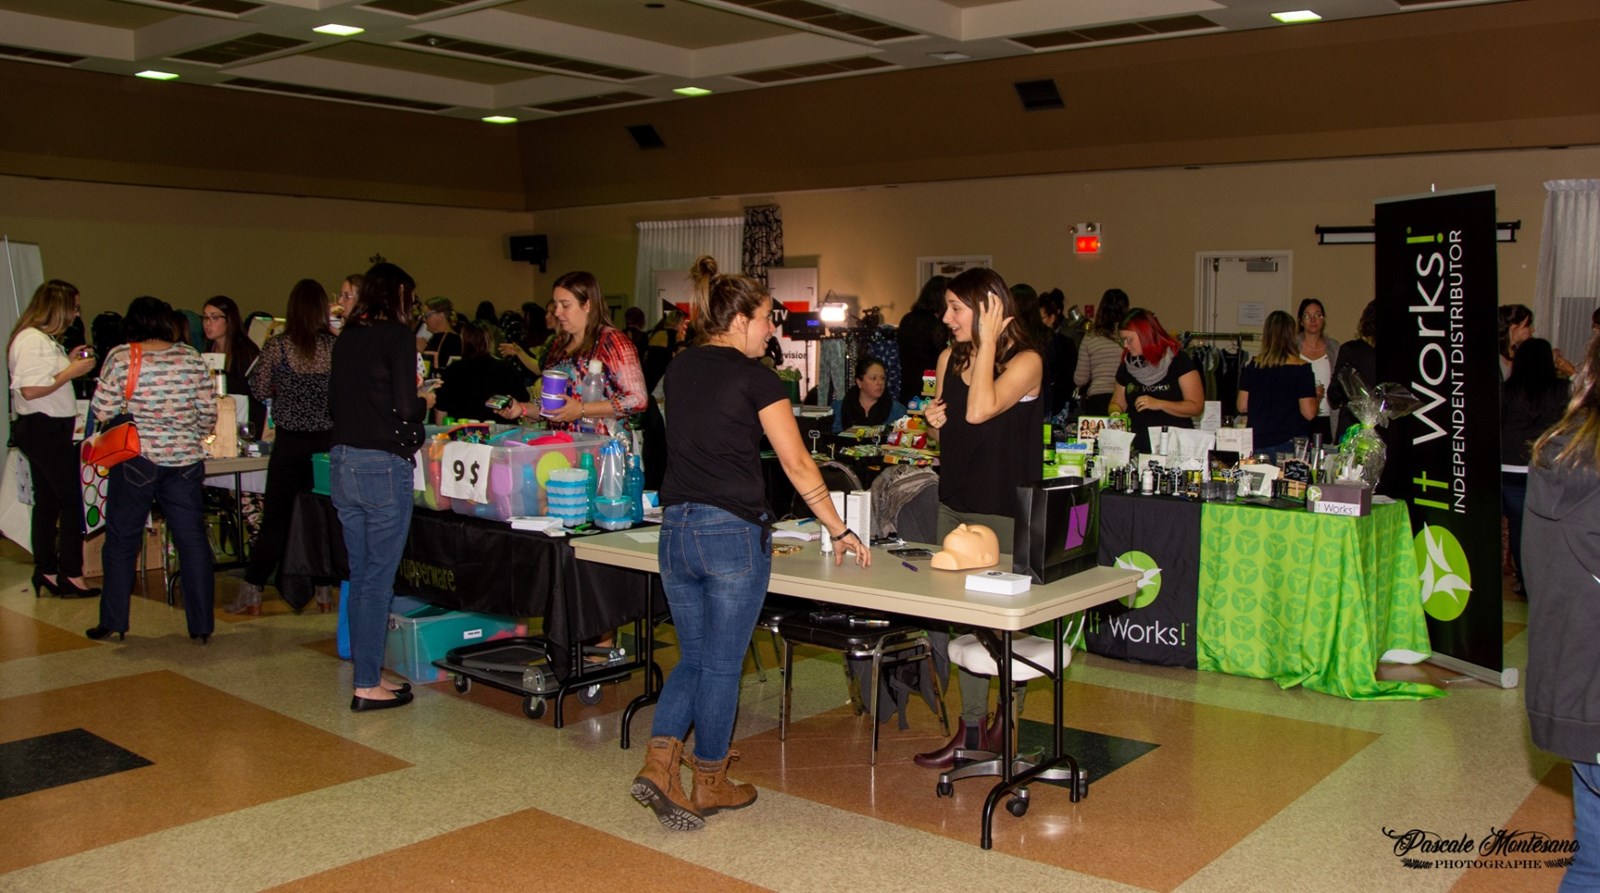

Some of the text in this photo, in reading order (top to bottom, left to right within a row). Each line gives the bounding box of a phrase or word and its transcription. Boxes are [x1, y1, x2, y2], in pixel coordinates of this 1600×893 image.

[1407, 232, 1449, 510] It Works!
[1449, 230, 1466, 514] INDEPENDENT DISTRIBUTOR
[453, 459, 480, 487] 9 $
[1089, 611, 1186, 647] It Works!
